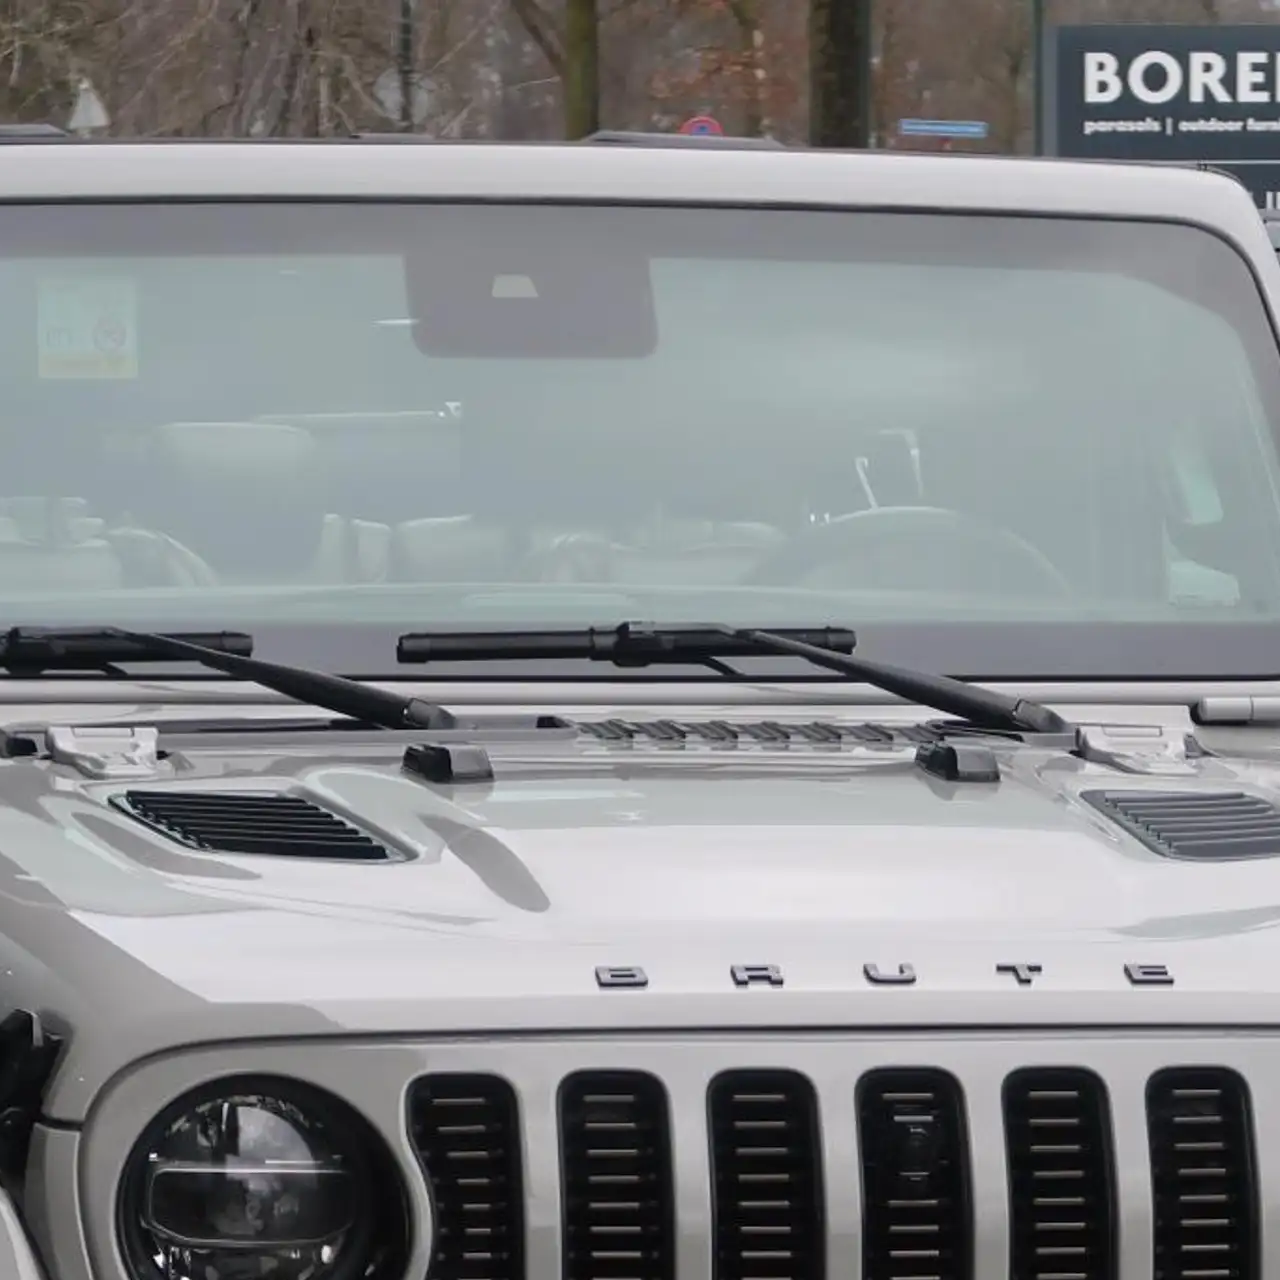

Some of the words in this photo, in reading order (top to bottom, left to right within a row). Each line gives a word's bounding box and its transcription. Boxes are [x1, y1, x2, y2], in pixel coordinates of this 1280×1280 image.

[1083, 117, 1161, 135] parasols
[1178, 117, 1243, 132] outdoor
[595, 962, 1176, 989] BRUTE
